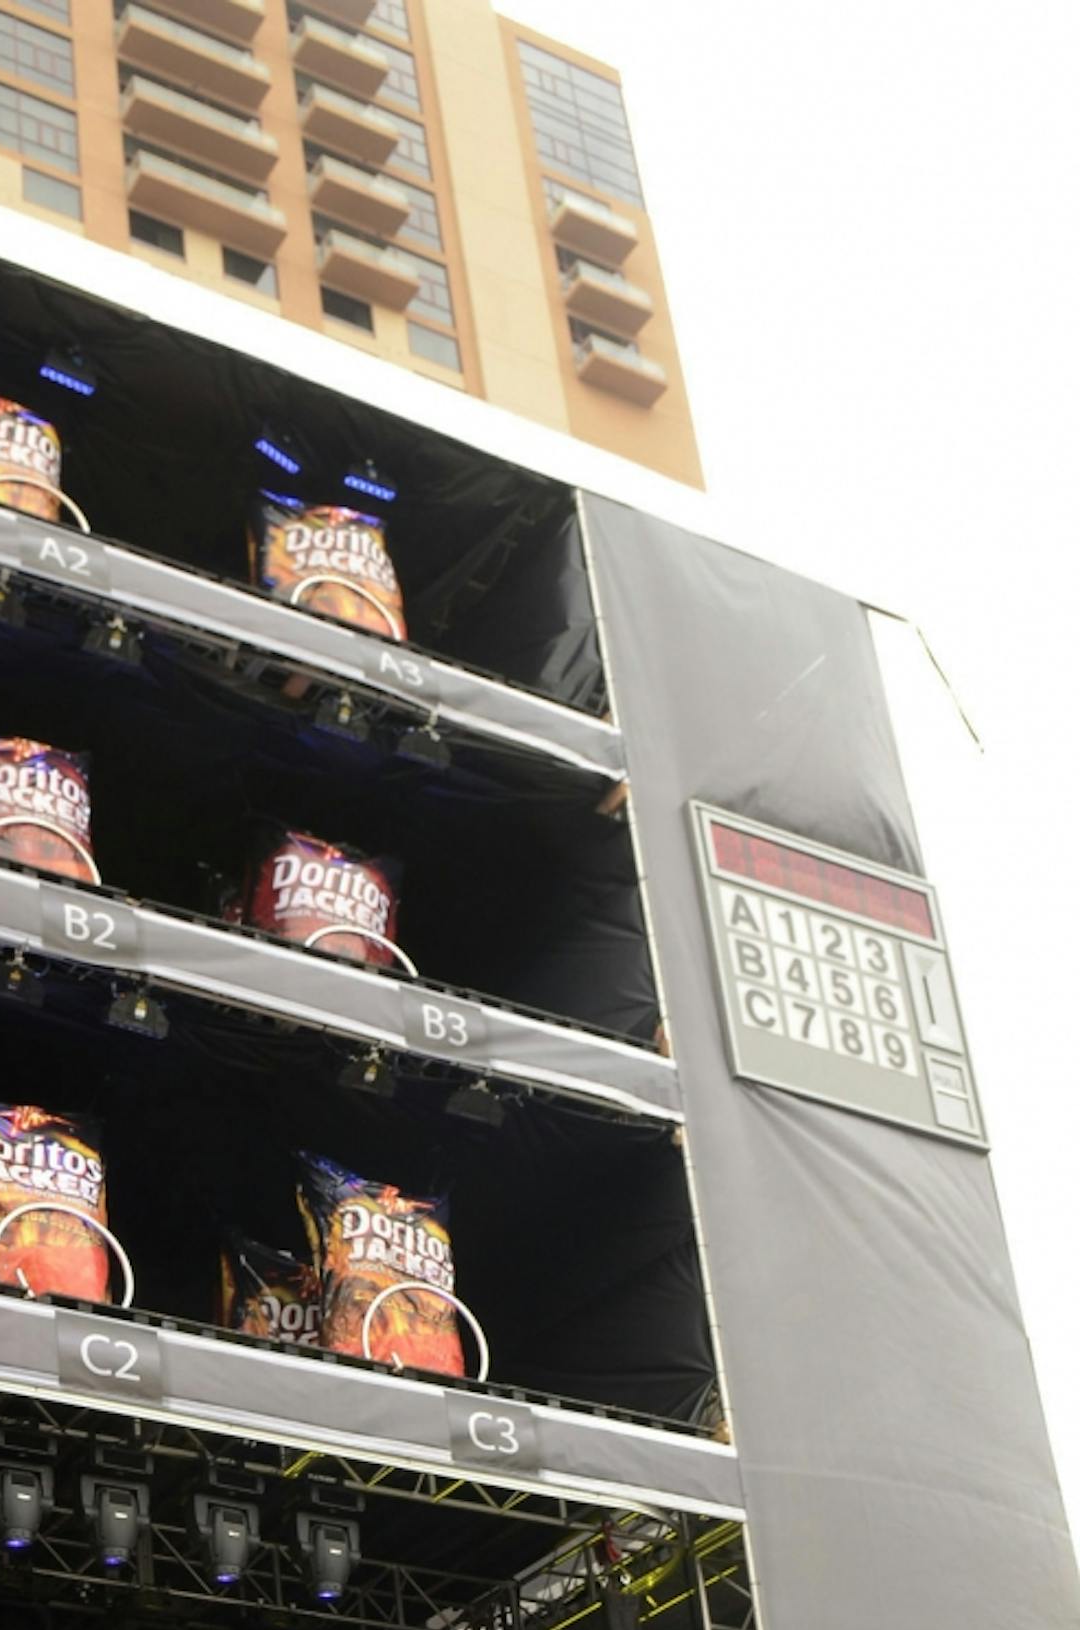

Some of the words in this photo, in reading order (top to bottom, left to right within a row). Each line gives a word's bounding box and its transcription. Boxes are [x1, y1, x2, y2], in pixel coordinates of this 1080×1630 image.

[38, 536, 92, 577] A2
[379, 651, 424, 687] A3
[273, 855, 390, 920] Doritos
[63, 902, 117, 949] B2
[730, 894, 760, 933] A
[778, 911, 798, 944] 1
[821, 924, 848, 961] 2
[864, 938, 890, 974] 3
[735, 939, 767, 978] B
[786, 958, 810, 992] 4
[831, 971, 855, 1006] 5
[874, 985, 898, 1021] 6
[421, 1003, 470, 1046] B3
[745, 989, 776, 1028] C
[793, 1002, 817, 1039] 7
[841, 1020, 865, 1056] 8
[885, 1033, 908, 1069] 9
[338, 1205, 453, 1271] Dorito
[81, 1333, 140, 1381] C2
[468, 1411, 519, 1453] C3
